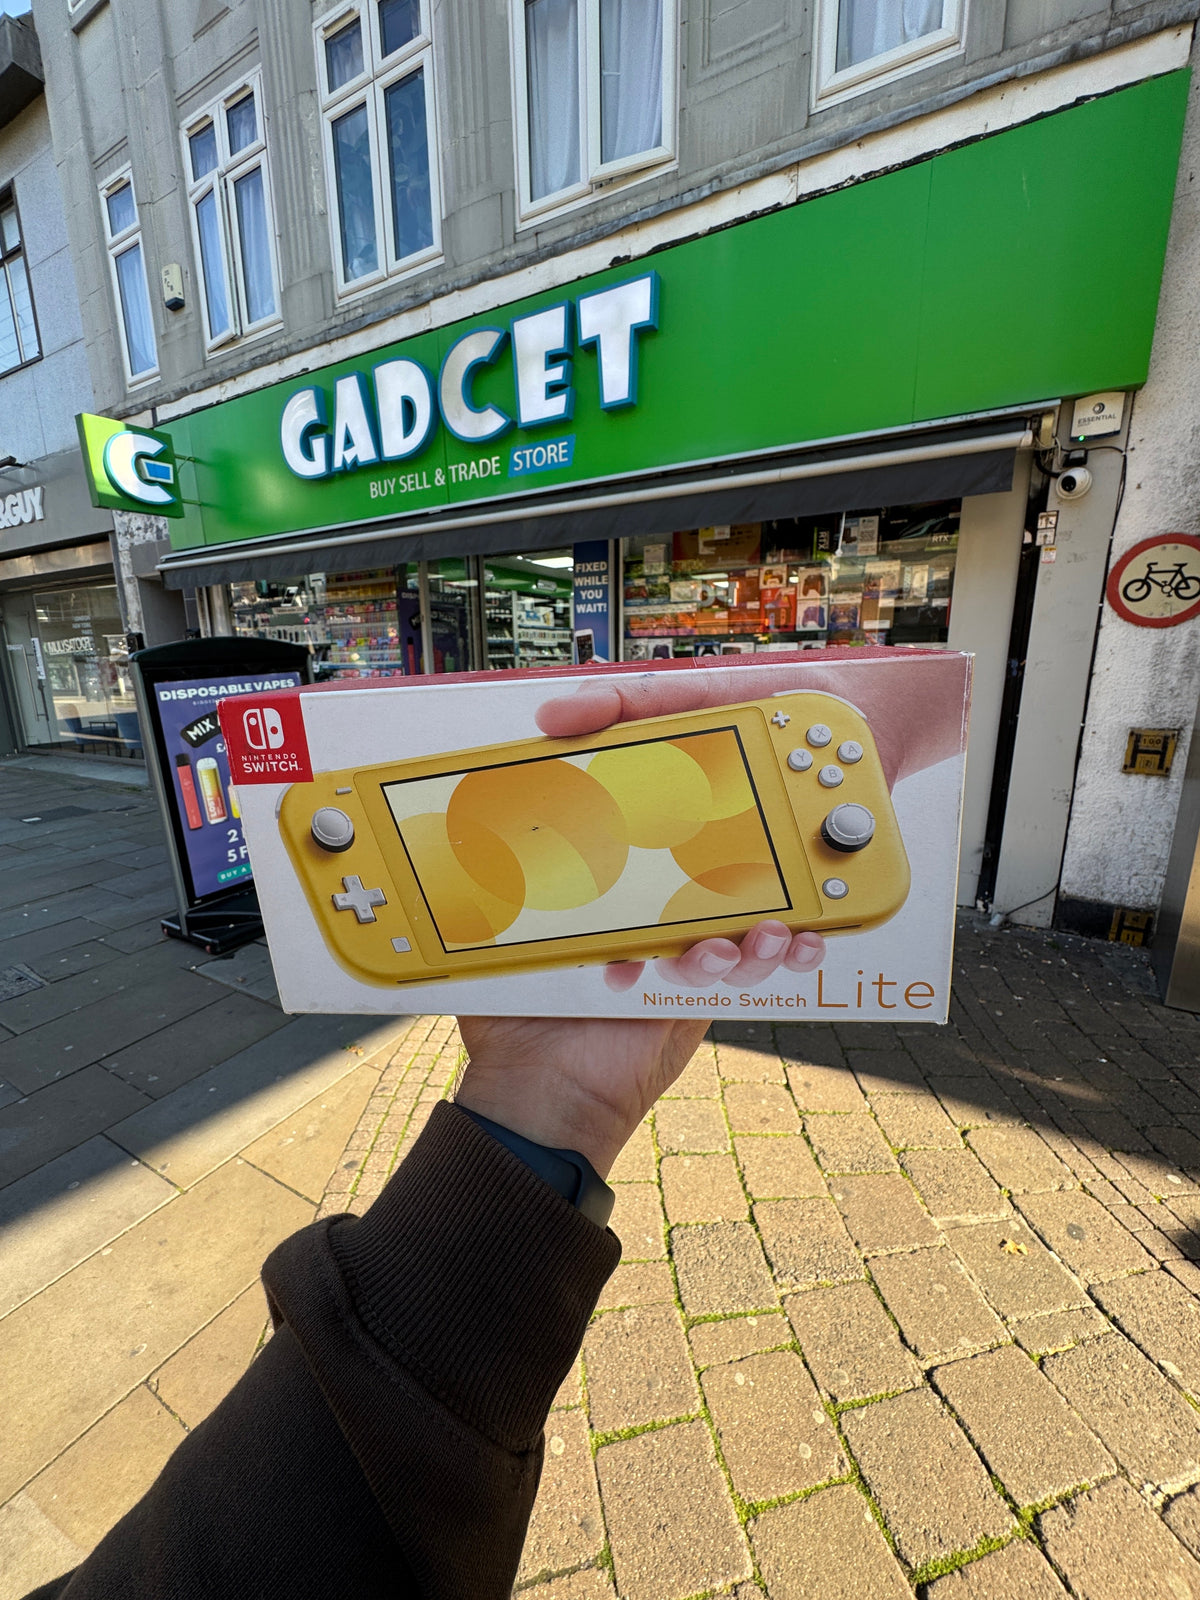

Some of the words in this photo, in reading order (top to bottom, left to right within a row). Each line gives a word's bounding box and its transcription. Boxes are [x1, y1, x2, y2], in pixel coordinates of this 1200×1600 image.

[280, 271, 660, 479] GADCET
[1078, 414, 1117, 425] ESSENTIAL
[370, 478, 396, 499] BUY
[400, 472, 431, 493] SELL
[434, 467, 446, 486] &
[448, 456, 501, 483] TRADE
[513, 441, 569, 471] STORE
[575, 561, 608, 573] FIXED
[575, 575, 609, 587] WHILE
[580, 589, 603, 600] YOU
[576, 603, 607, 614] WAIT!
[160, 683, 253, 701] DISPOSABLE
[253, 678, 296, 691] VAPES
[186, 718, 215, 741] MIX
[816, 728, 827, 738] X
[847, 745, 858, 754] A
[241, 753, 297, 761] NINTENDO
[796, 752, 805, 762] Y
[243, 760, 299, 773] SWITCH
[828, 769, 838, 778] B
[227, 828, 239, 843] 2
[227, 849, 238, 862] 5
[220, 870, 238, 880] BUY
[643, 992, 732, 1006] Nintendo
[739, 993, 807, 1008] Switch
[817, 969, 936, 1010] Lite
